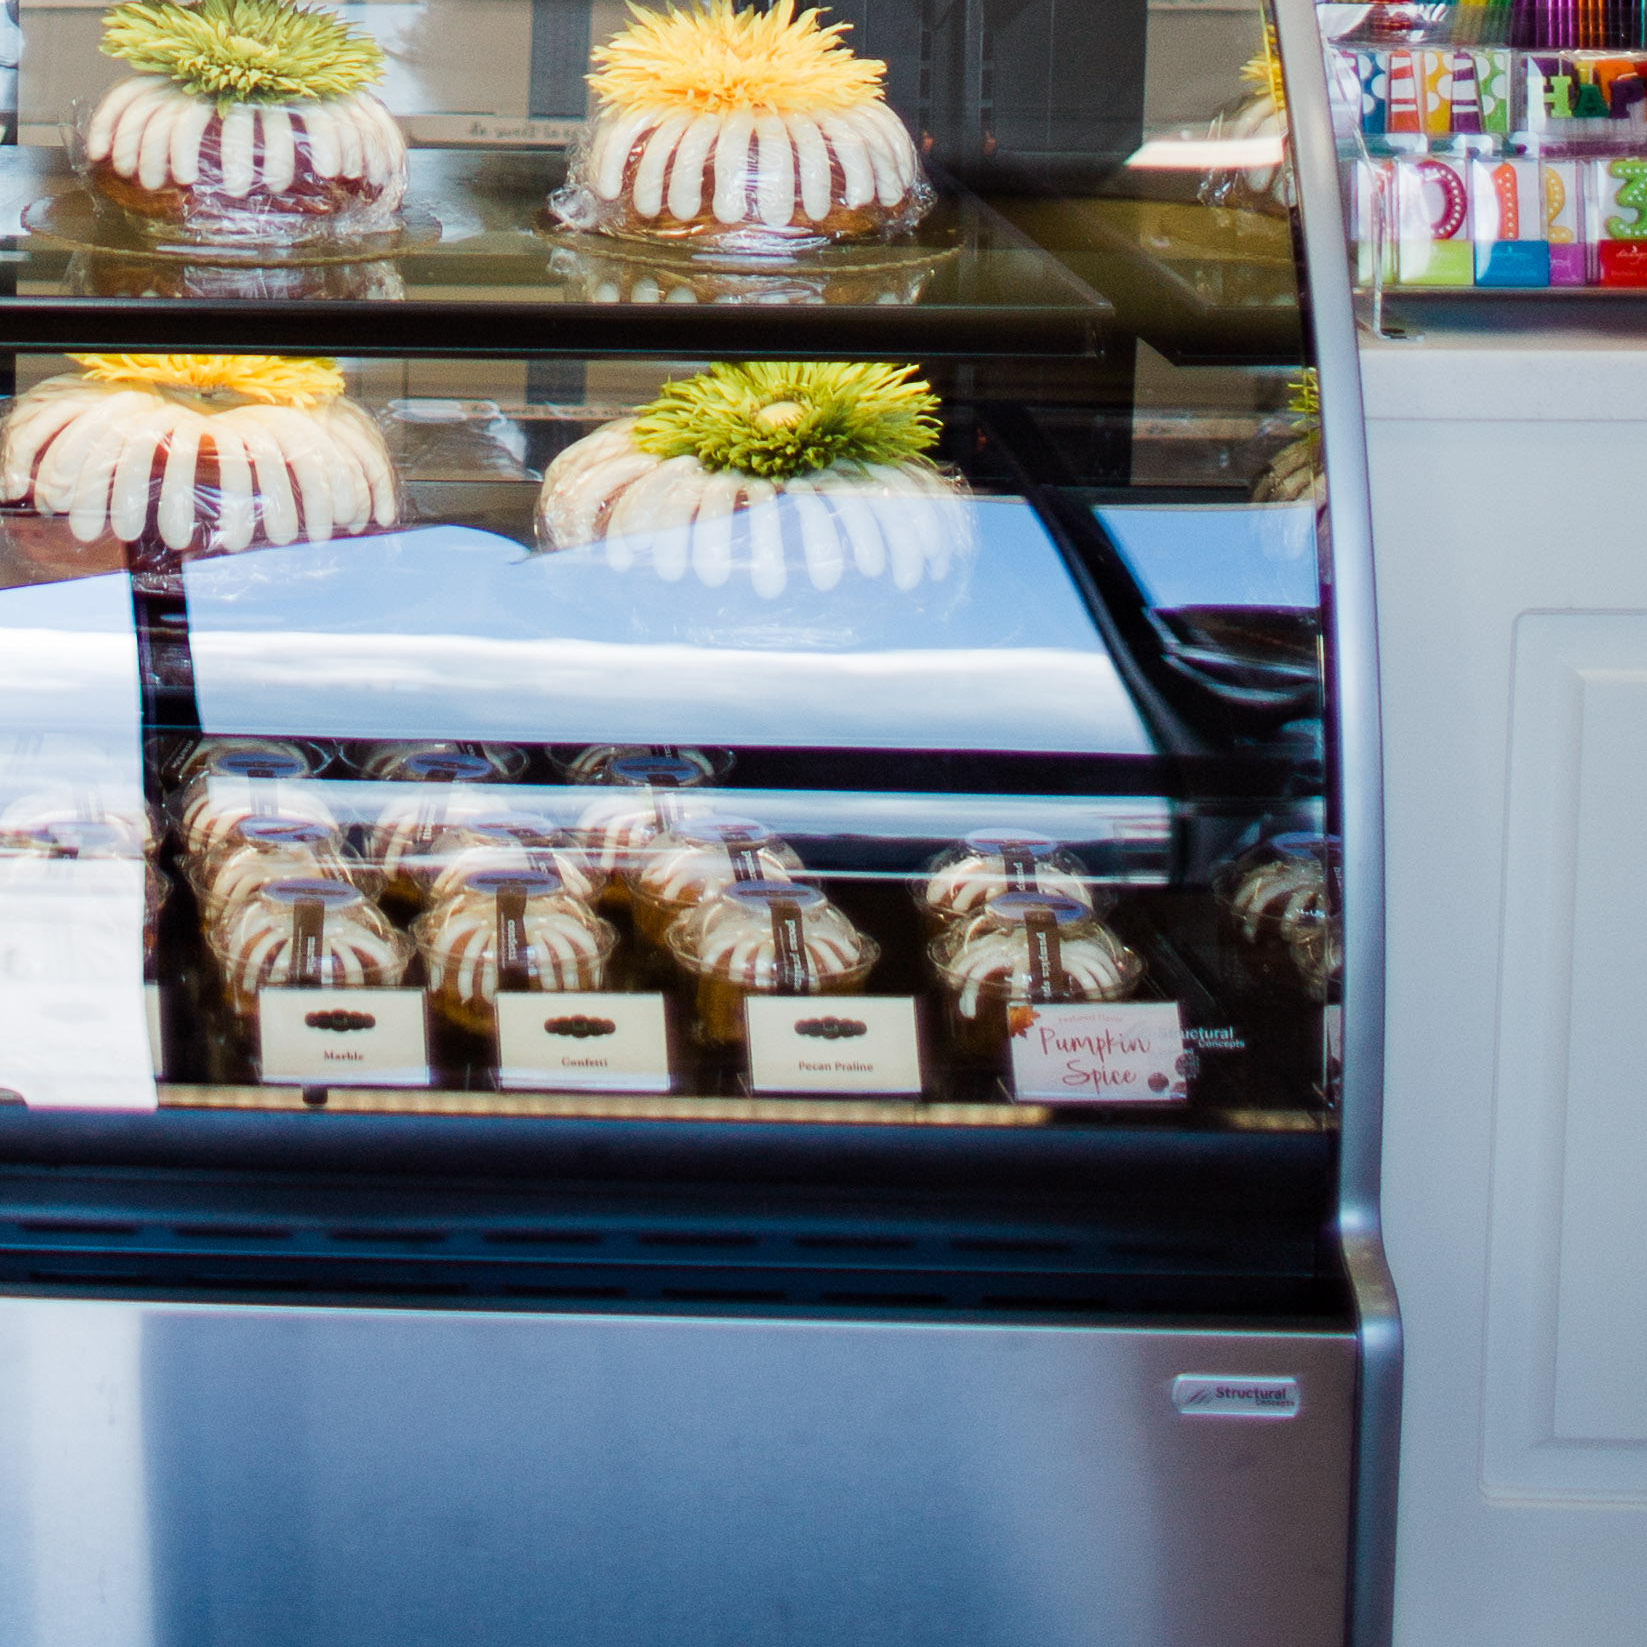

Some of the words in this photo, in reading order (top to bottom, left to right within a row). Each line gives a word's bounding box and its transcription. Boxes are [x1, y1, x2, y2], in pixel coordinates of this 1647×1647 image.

[1040, 1026, 1150, 1062] Pumpkin
[323, 1050, 364, 1061] Marble
[562, 1056, 608, 1068] Confetti
[798, 1060, 831, 1073] Pecan
[834, 1060, 874, 1073] Praline
[1063, 1059, 1137, 1095] Spice
[1216, 1387, 1286, 1399] Structural
